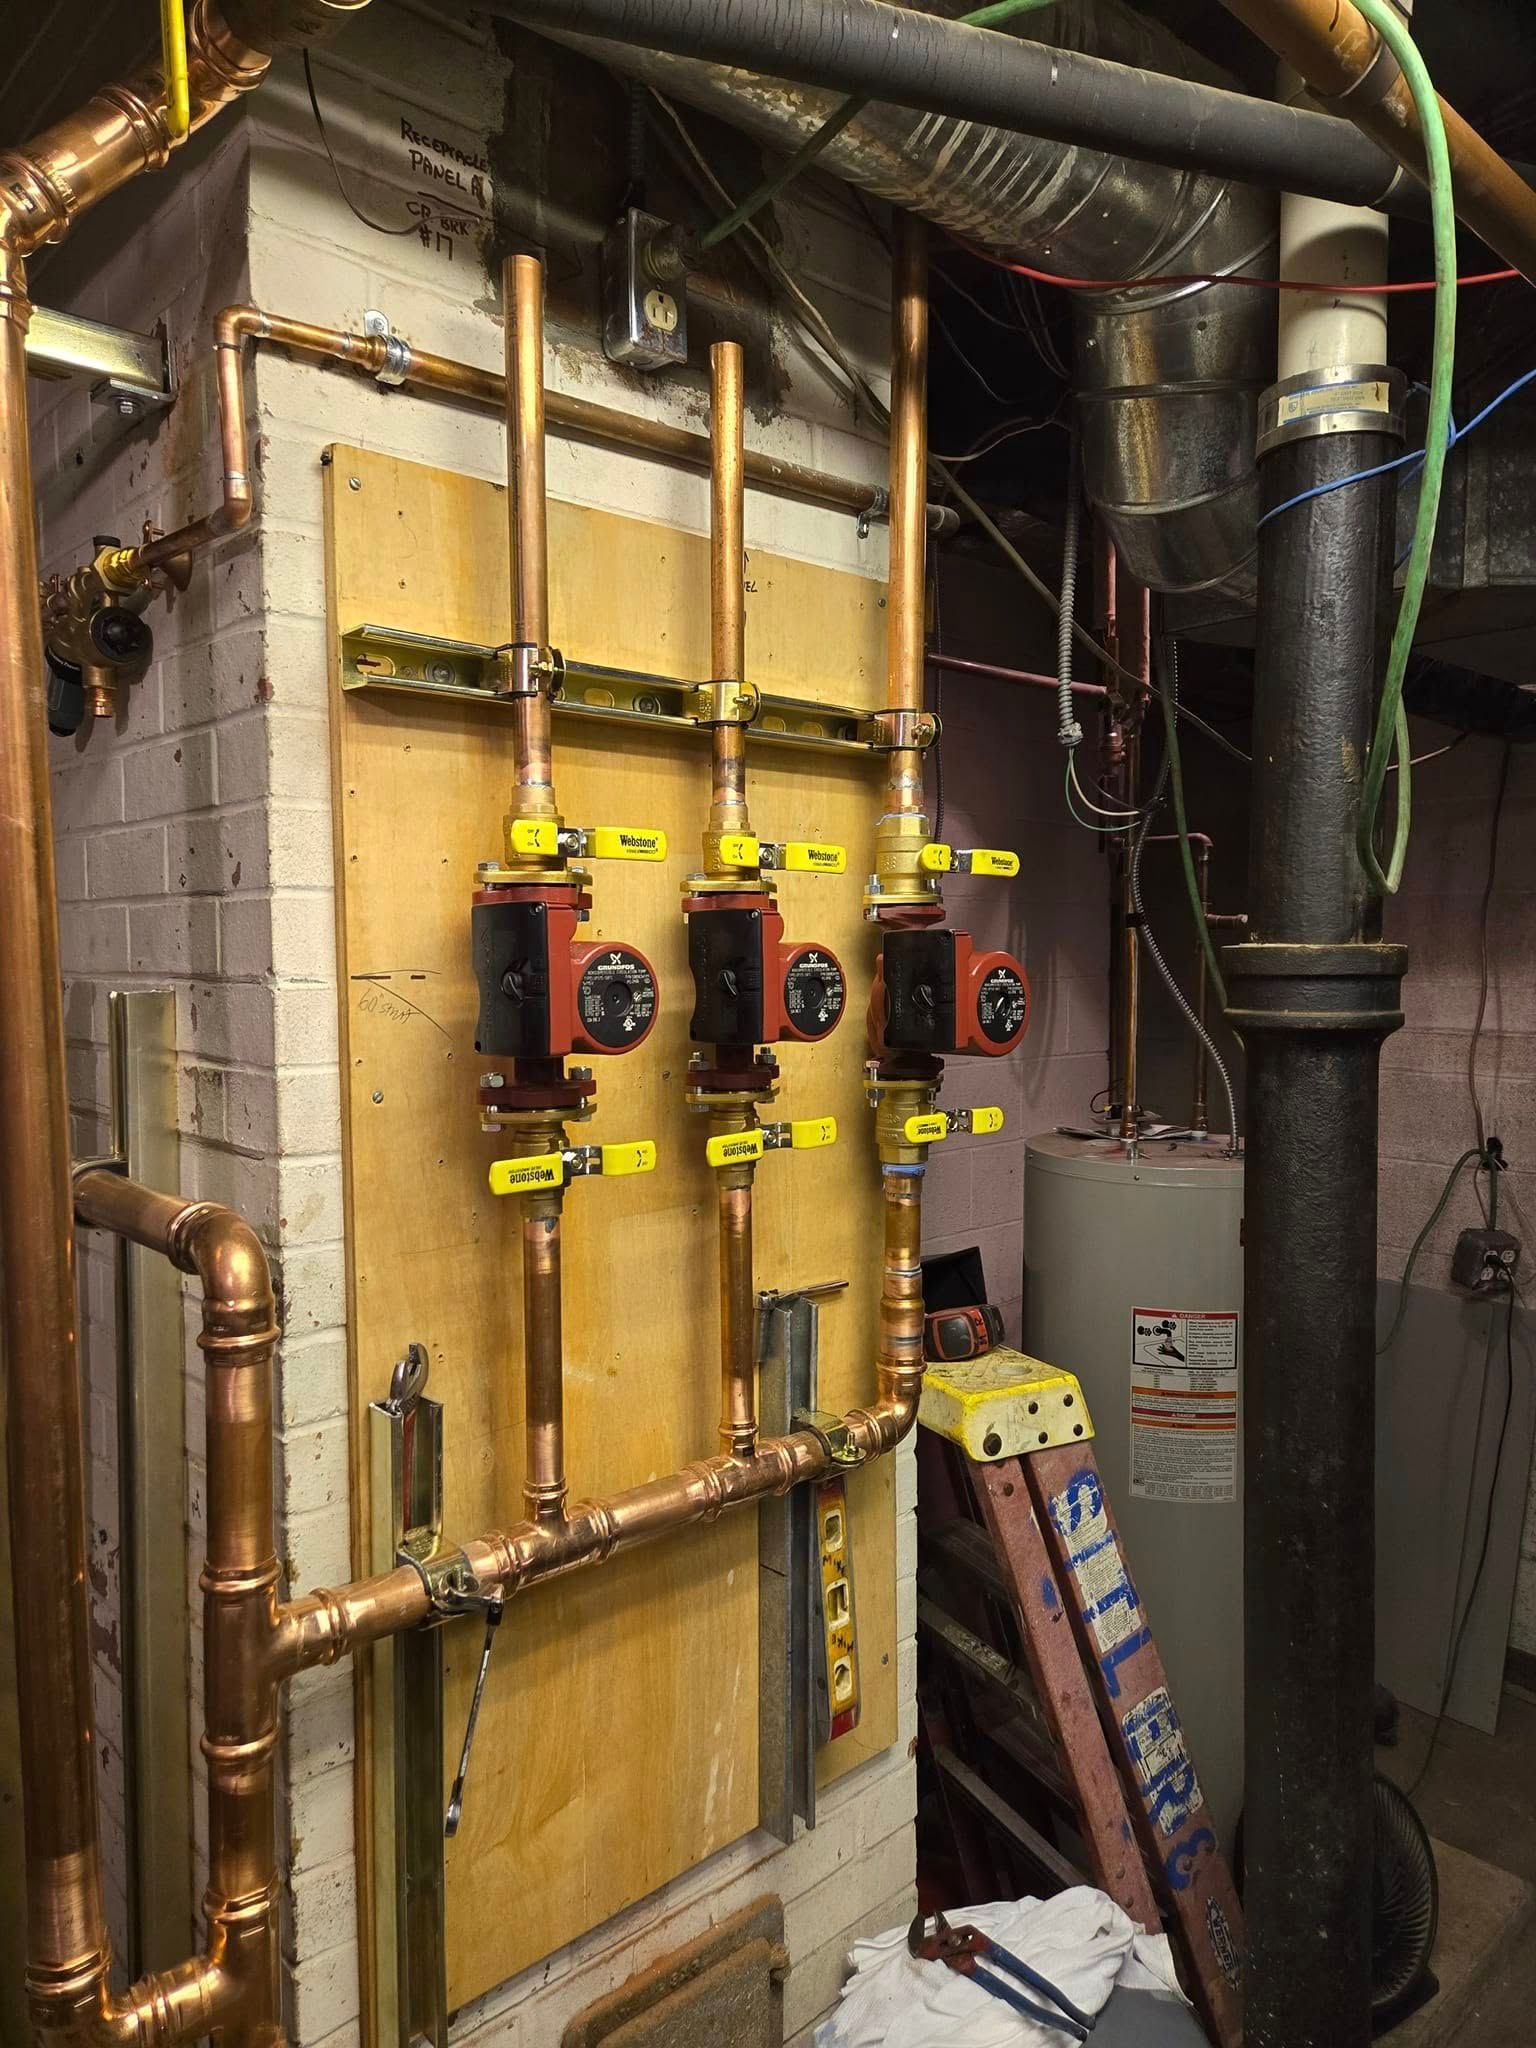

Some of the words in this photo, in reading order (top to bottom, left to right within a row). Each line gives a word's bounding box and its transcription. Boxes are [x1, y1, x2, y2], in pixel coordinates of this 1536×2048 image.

[408, 149, 467, 191] PANEL
[419, 224, 453, 261] #17
[619, 834, 656, 848] Webstone
[807, 849, 838, 862] Webstone
[597, 963, 635, 971] GRUNDFOS
[722, 1143, 758, 1158] Webstone
[509, 1168, 555, 1185] Webstone
